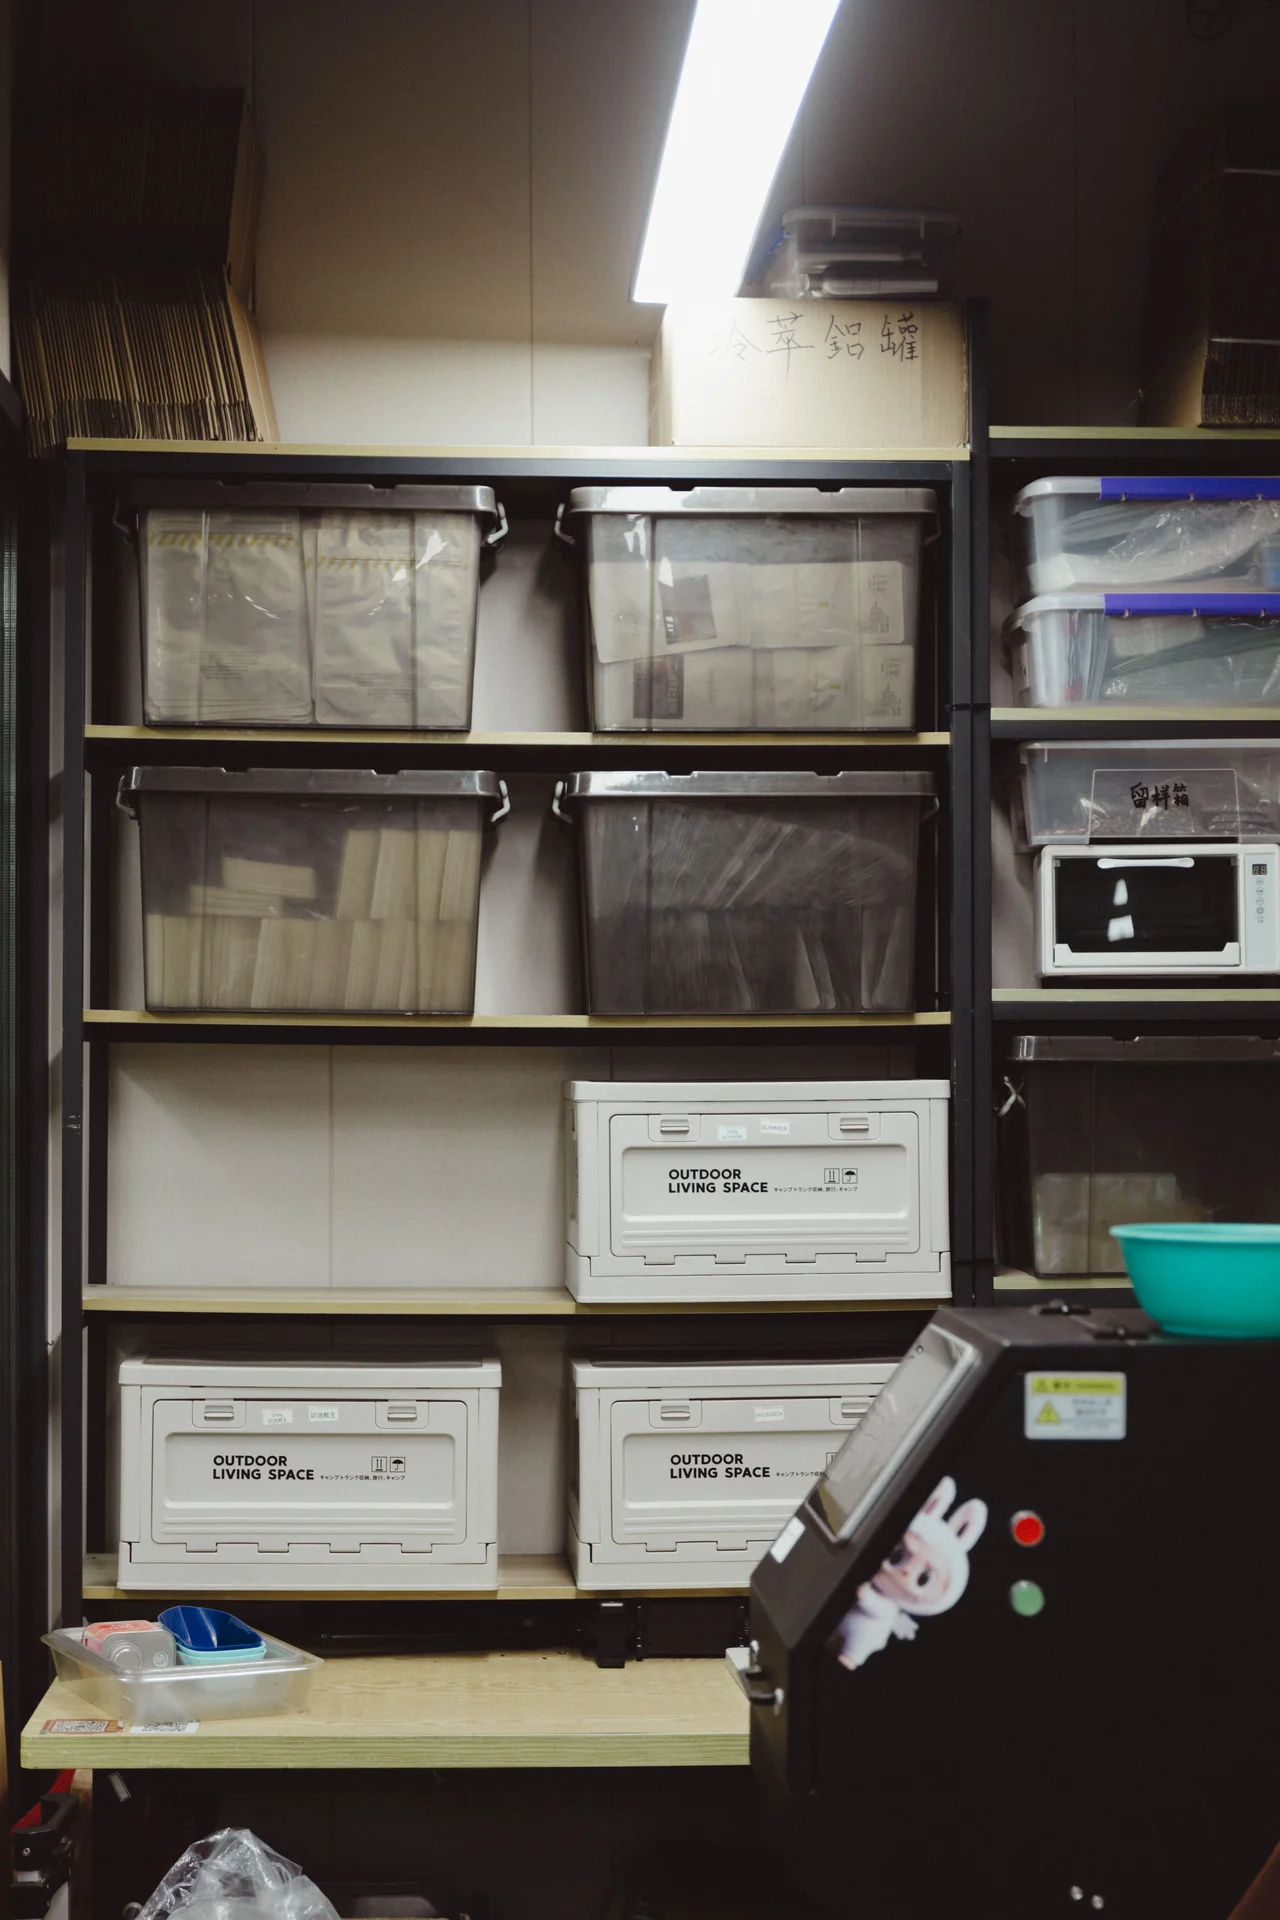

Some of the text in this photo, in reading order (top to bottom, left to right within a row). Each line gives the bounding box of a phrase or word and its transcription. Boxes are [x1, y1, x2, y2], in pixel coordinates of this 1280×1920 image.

[1129, 781, 1190, 811] 留样箱
[668, 1168, 742, 1181] OUTDOOR
[668, 1182, 769, 1194] LIVING SPACE
[213, 1454, 288, 1467] OUTDOOR
[670, 1453, 744, 1466] OUTDOOR
[212, 1468, 315, 1480] LIVING SPACE
[670, 1466, 770, 1479] LIVING SPACE
